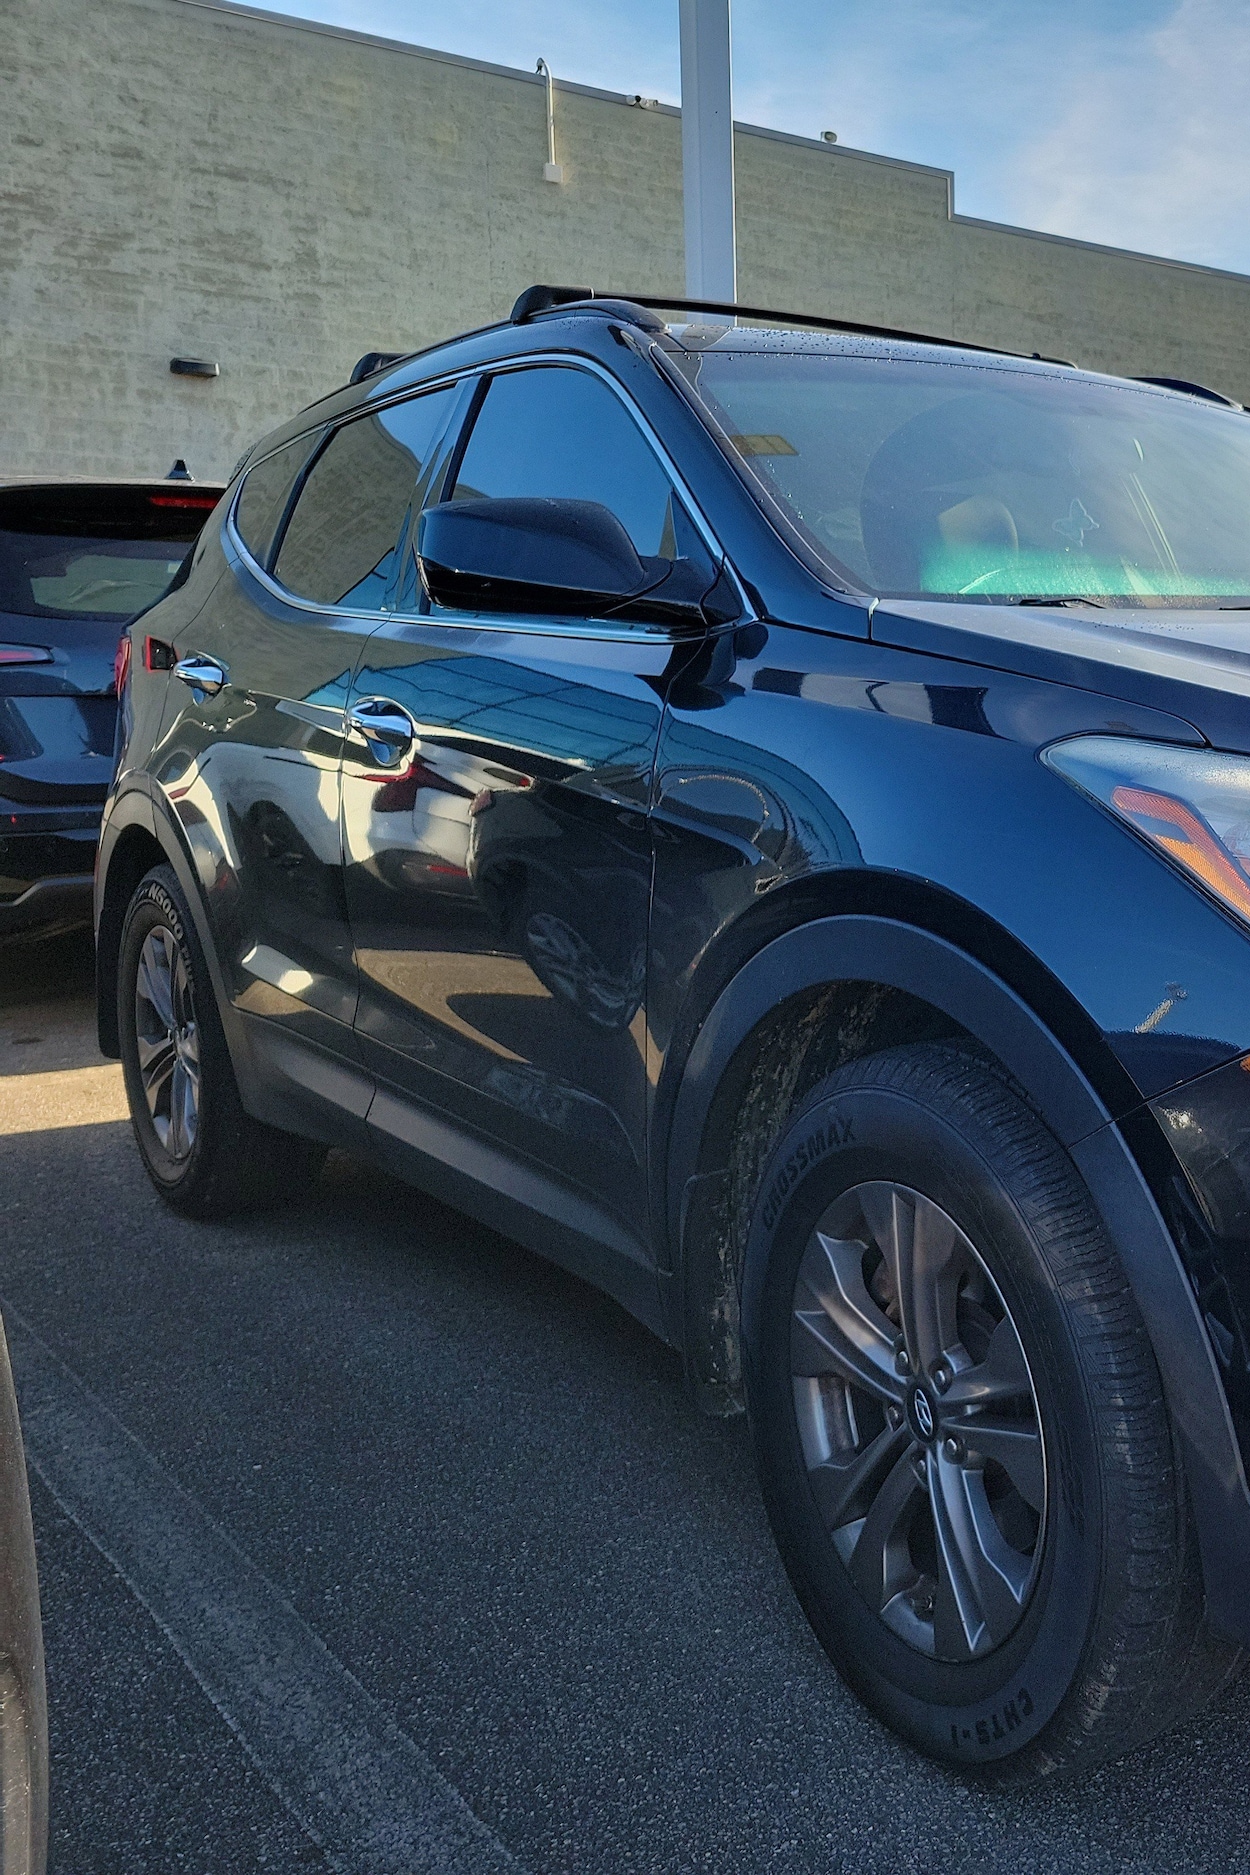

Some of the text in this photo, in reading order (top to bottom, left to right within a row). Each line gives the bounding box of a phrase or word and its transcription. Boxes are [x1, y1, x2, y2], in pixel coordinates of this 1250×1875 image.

[148, 882, 184, 940] N5000
[762, 1115, 856, 1230] CROSSMAX
[950, 1688, 1034, 1748] CHTS-1
